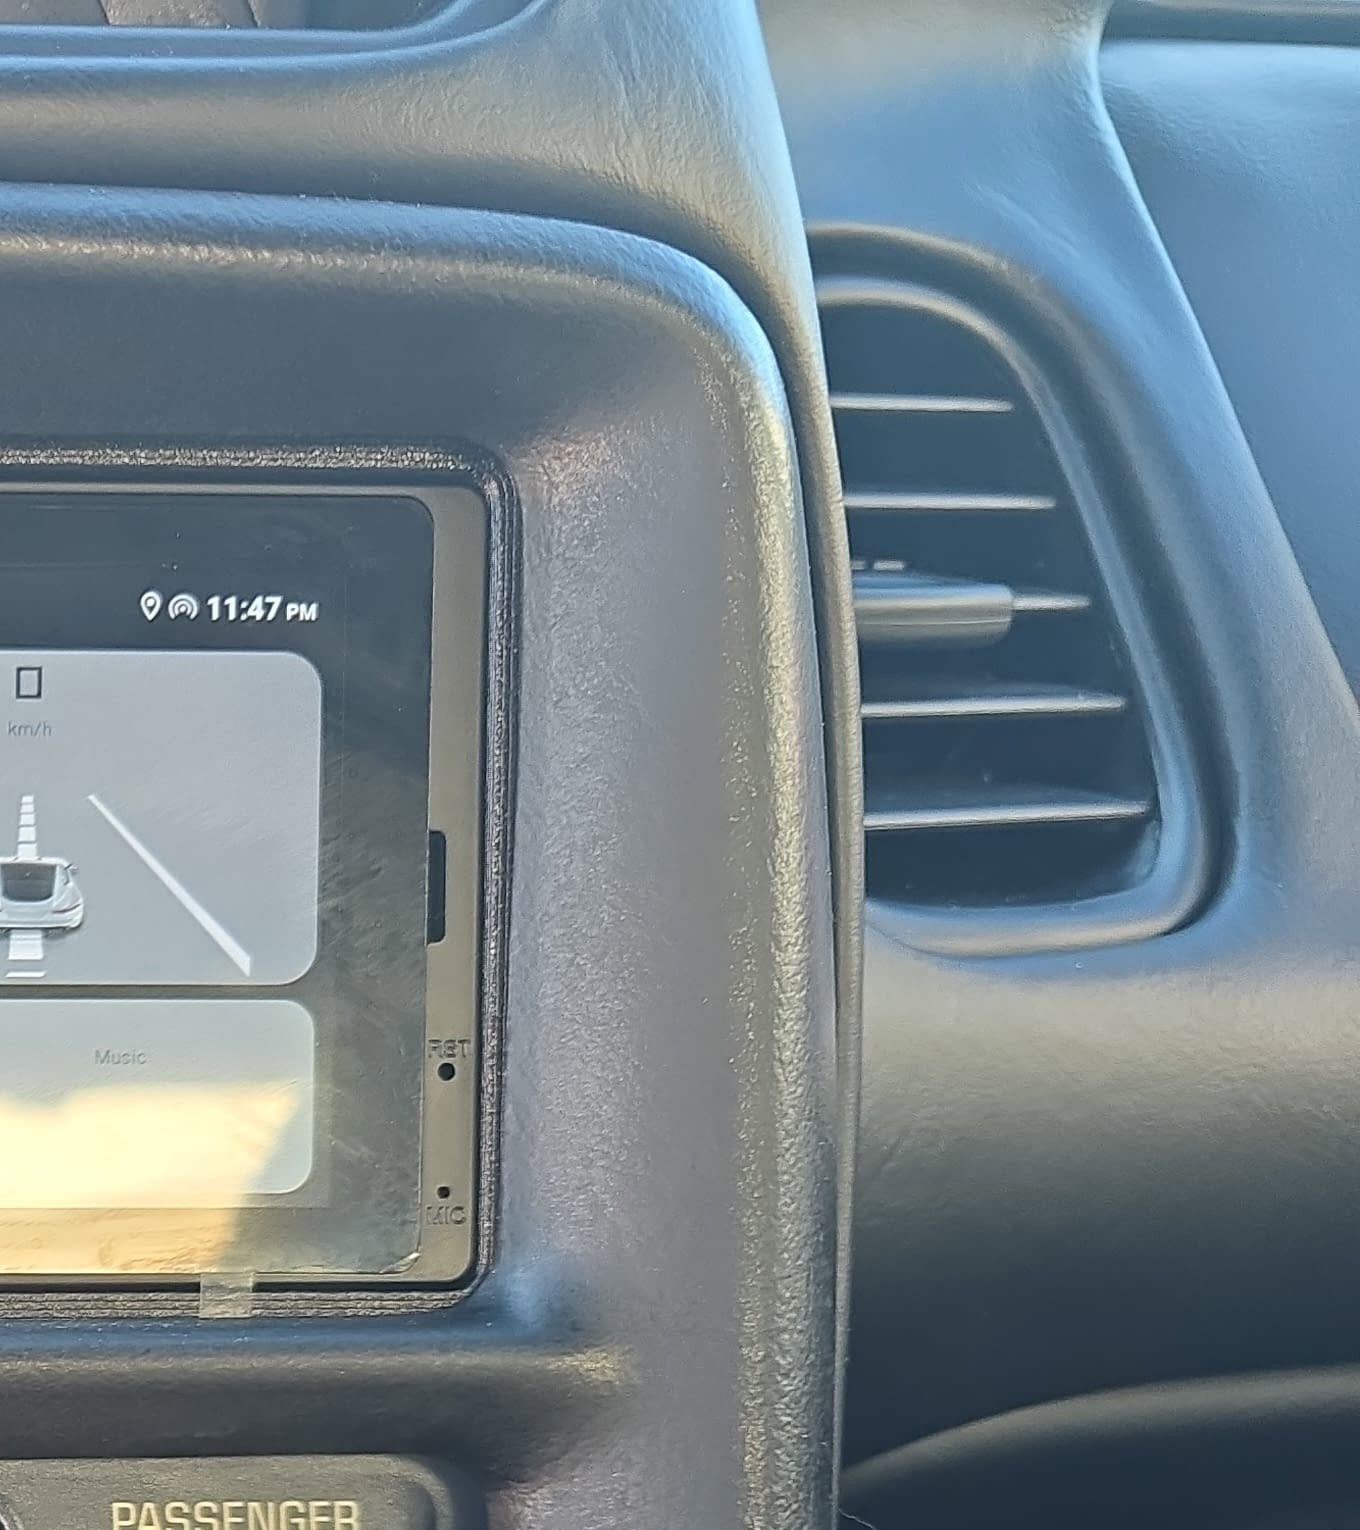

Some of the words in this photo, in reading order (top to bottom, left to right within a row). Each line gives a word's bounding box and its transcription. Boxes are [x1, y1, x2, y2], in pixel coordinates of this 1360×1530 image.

[207, 595, 283, 621] 11:47
[286, 603, 319, 621] PM
[8, 720, 53, 737] km/h
[94, 1048, 148, 1065] Music
[425, 1206, 466, 1225] MIC
